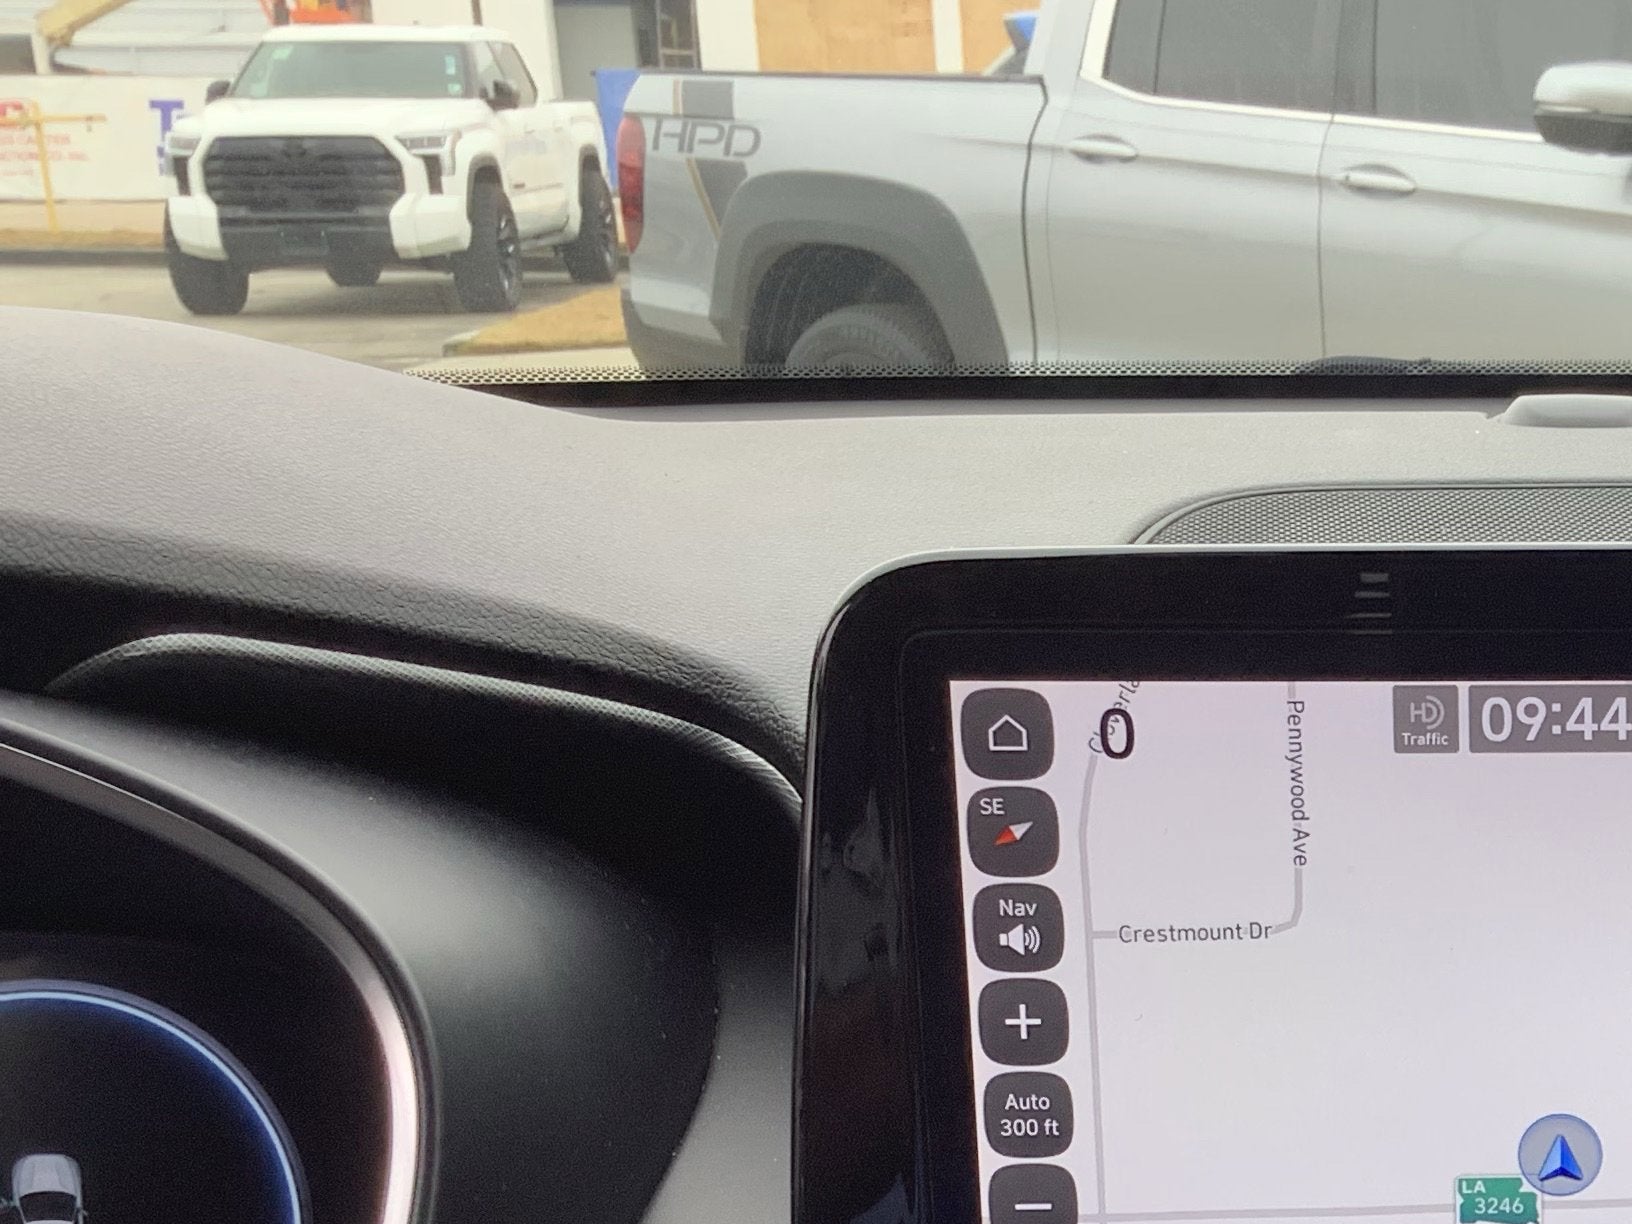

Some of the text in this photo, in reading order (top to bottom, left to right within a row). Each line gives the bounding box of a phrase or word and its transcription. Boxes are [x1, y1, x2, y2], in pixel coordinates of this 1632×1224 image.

[651, 114, 761, 157] HPD
[1401, 731, 1449, 747] Traffic
[1286, 699, 1311, 867] Pennywood Ave
[979, 797, 1005, 816] SE
[999, 899, 1038, 918] Nav
[1118, 922, 1274, 944] Crestmount Dr
[1004, 1093, 1051, 1111] Auto
[1000, 1119, 1060, 1137] 300 ft
[1461, 1180, 1487, 1195] LA
[1474, 1198, 1525, 1216] 3246
